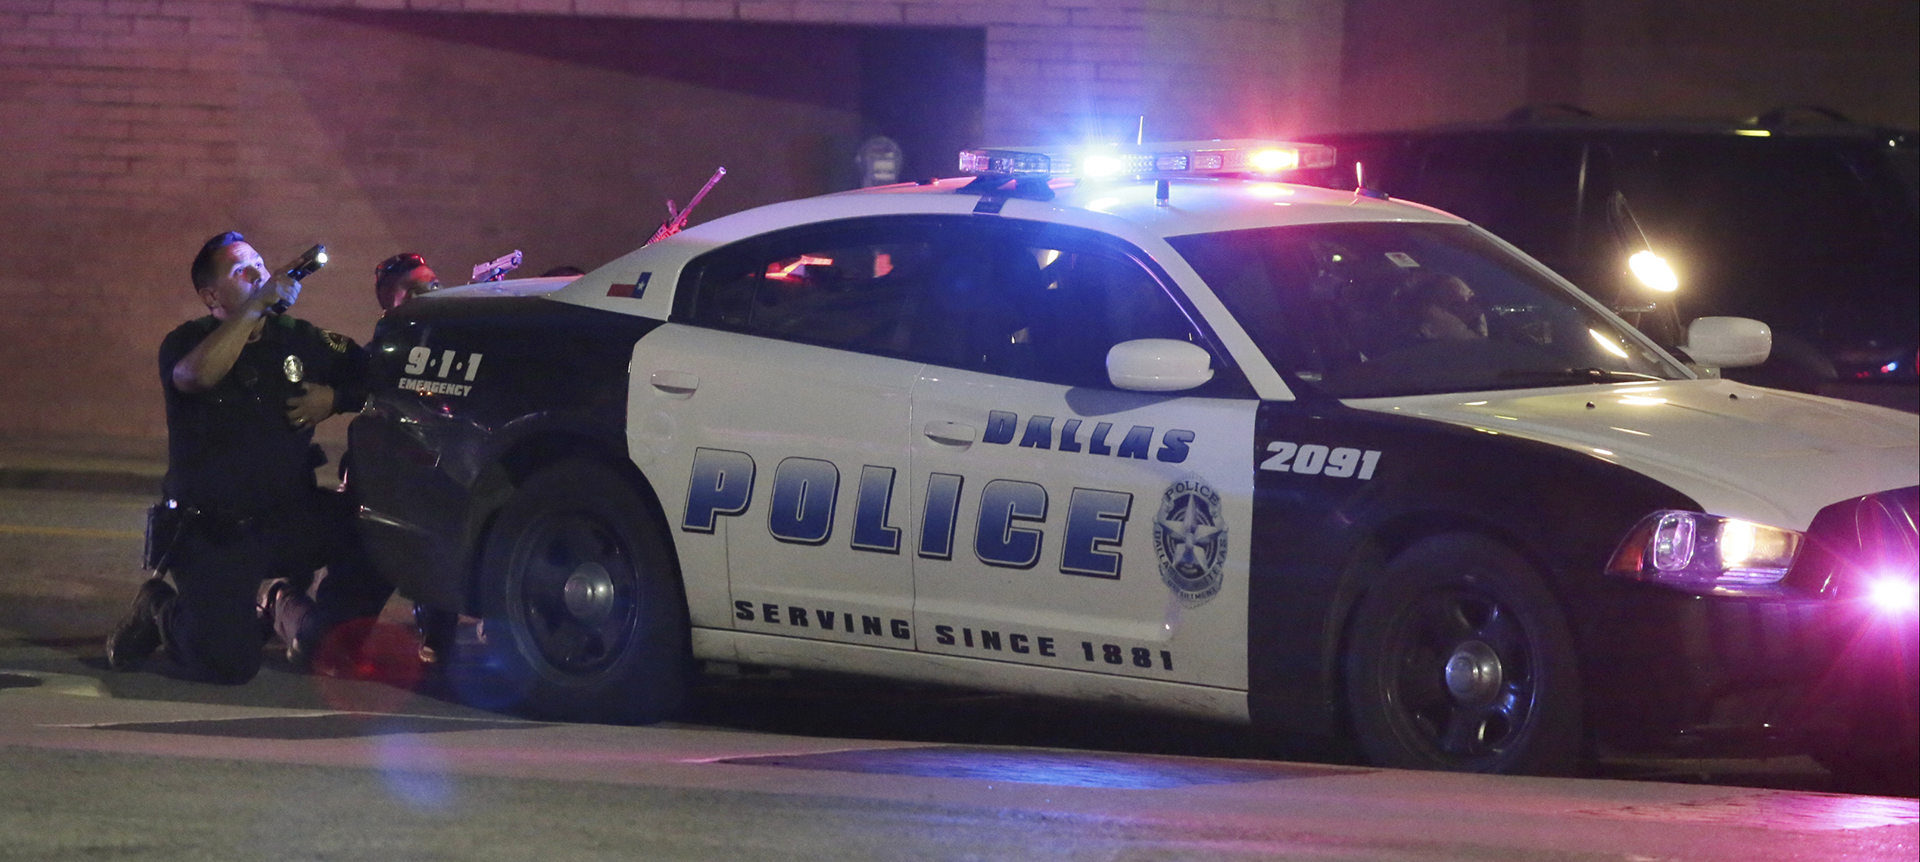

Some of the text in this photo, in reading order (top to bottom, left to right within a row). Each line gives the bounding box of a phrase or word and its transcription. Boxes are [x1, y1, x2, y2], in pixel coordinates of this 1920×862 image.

[398, 377, 473, 397] EMERGENCY
[982, 410, 1196, 464] DALLAS
[1260, 441, 1382, 480] 2091
[681, 446, 1134, 580] POLICE
[1164, 481, 1220, 507] POLICE
[1154, 530, 1174, 574] DALLA
[1207, 538, 1227, 581] TEXAS
[735, 600, 1173, 671] SERVING SINCE 1881
